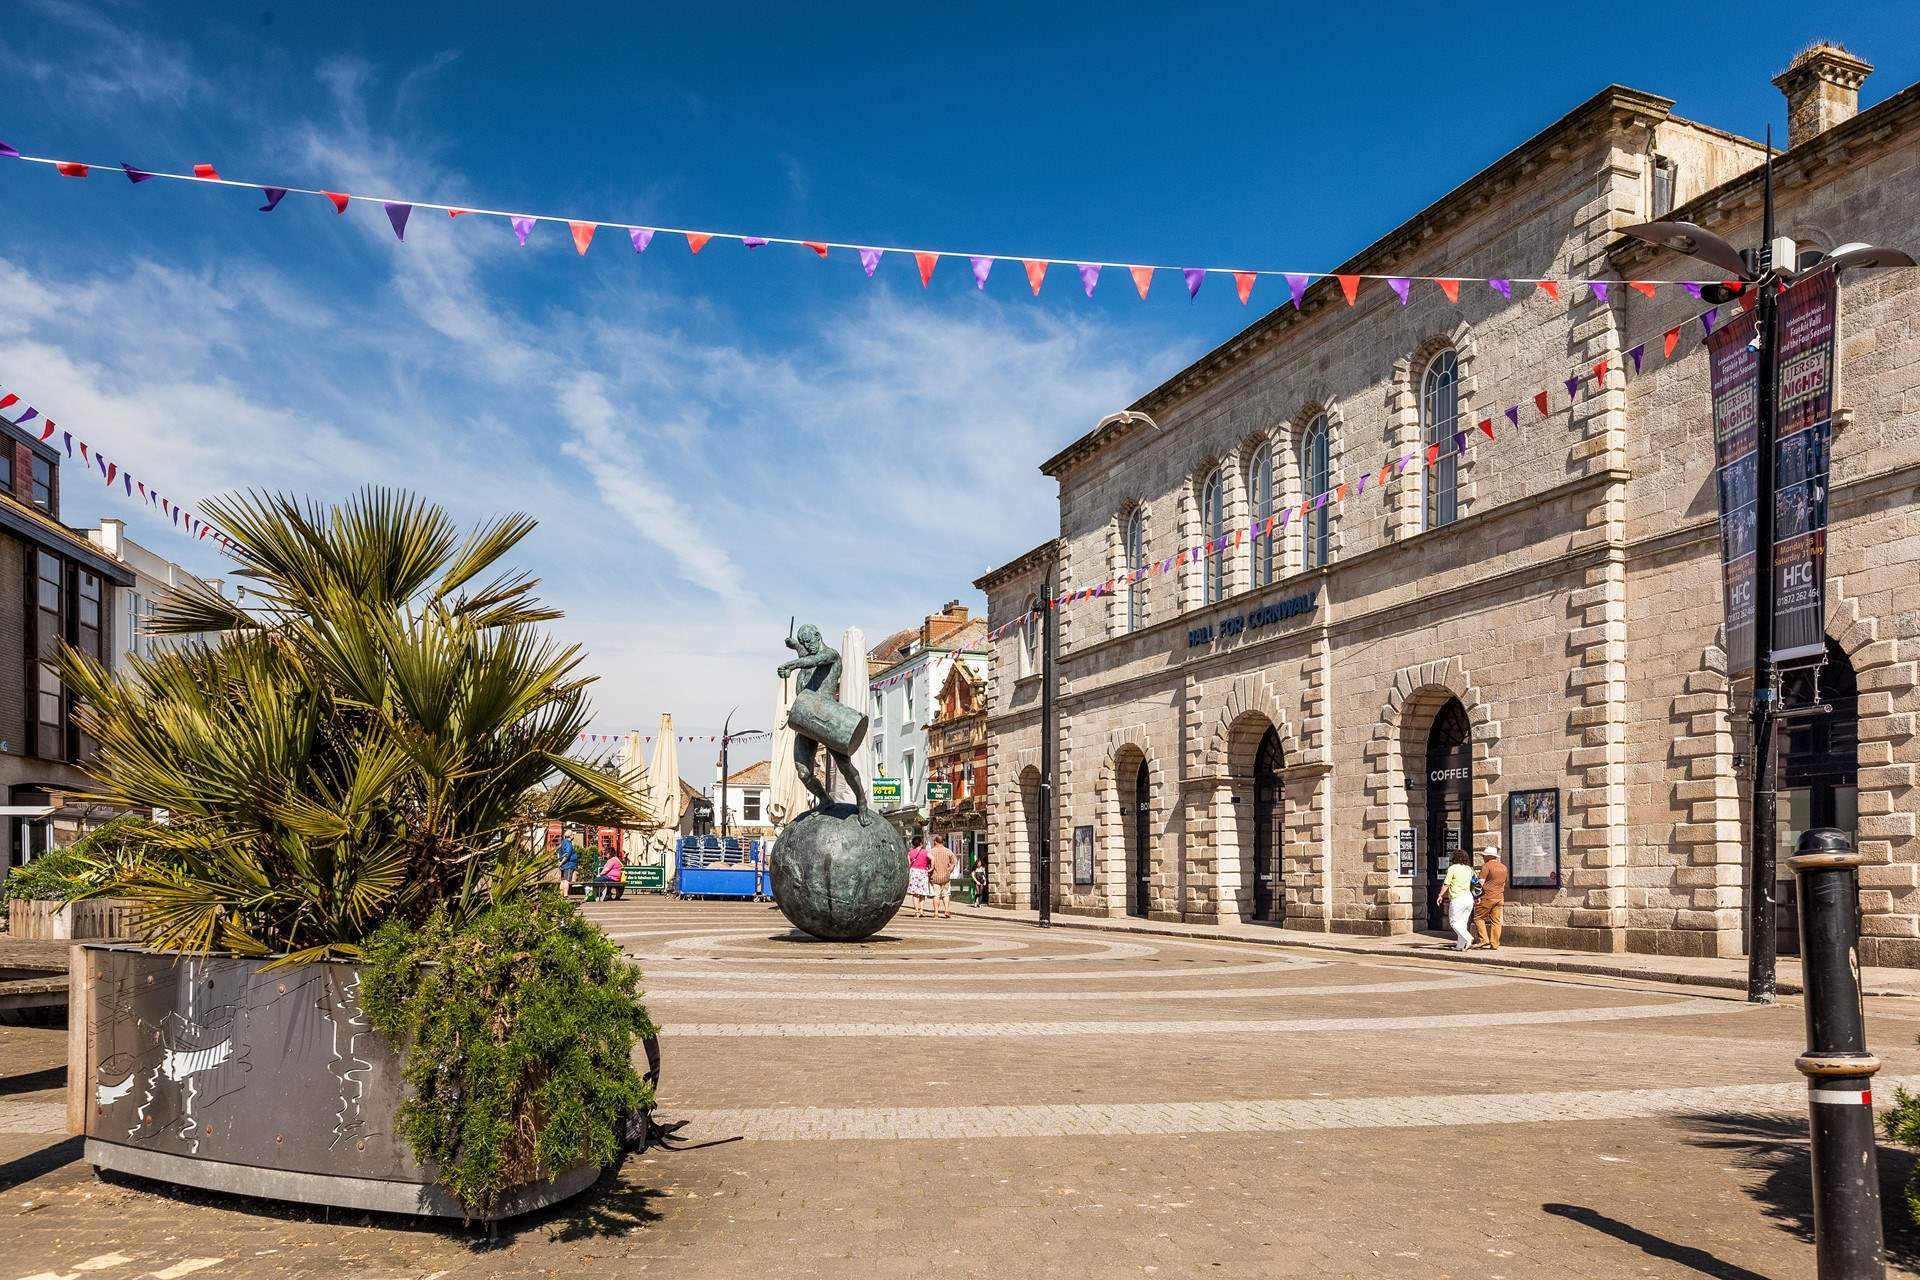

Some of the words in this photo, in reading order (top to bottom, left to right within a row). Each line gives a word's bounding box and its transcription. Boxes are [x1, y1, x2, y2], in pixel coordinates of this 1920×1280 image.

[1780, 341, 1790, 353] and
[1798, 334, 1810, 344] Four
[1810, 323, 1832, 339] Seasons
[1790, 321, 1808, 337] Frankie
[1809, 314, 1822, 328] Valli
[1740, 361, 1757, 376] Seasons
[1789, 354, 1822, 381] JERSEY
[1783, 368, 1823, 400] NIGHTS
[1724, 388, 1751, 414] JERSEY
[1720, 402, 1752, 434] NIGHTS
[1775, 552, 1800, 567] Saturday
[1780, 540, 1804, 555] Monday
[1783, 561, 1813, 588] HFC
[1731, 580, 1750, 606] HFC
[1776, 592, 1795, 607] 01872
[1796, 590, 1807, 601] 262
[1188, 624, 1213, 648] HALL
[1219, 615, 1245, 638] FOR
[1248, 592, 1319, 630] CORNWALL
[1430, 767, 1468, 782] COFFEE
[1140, 802, 1150, 811] BO
